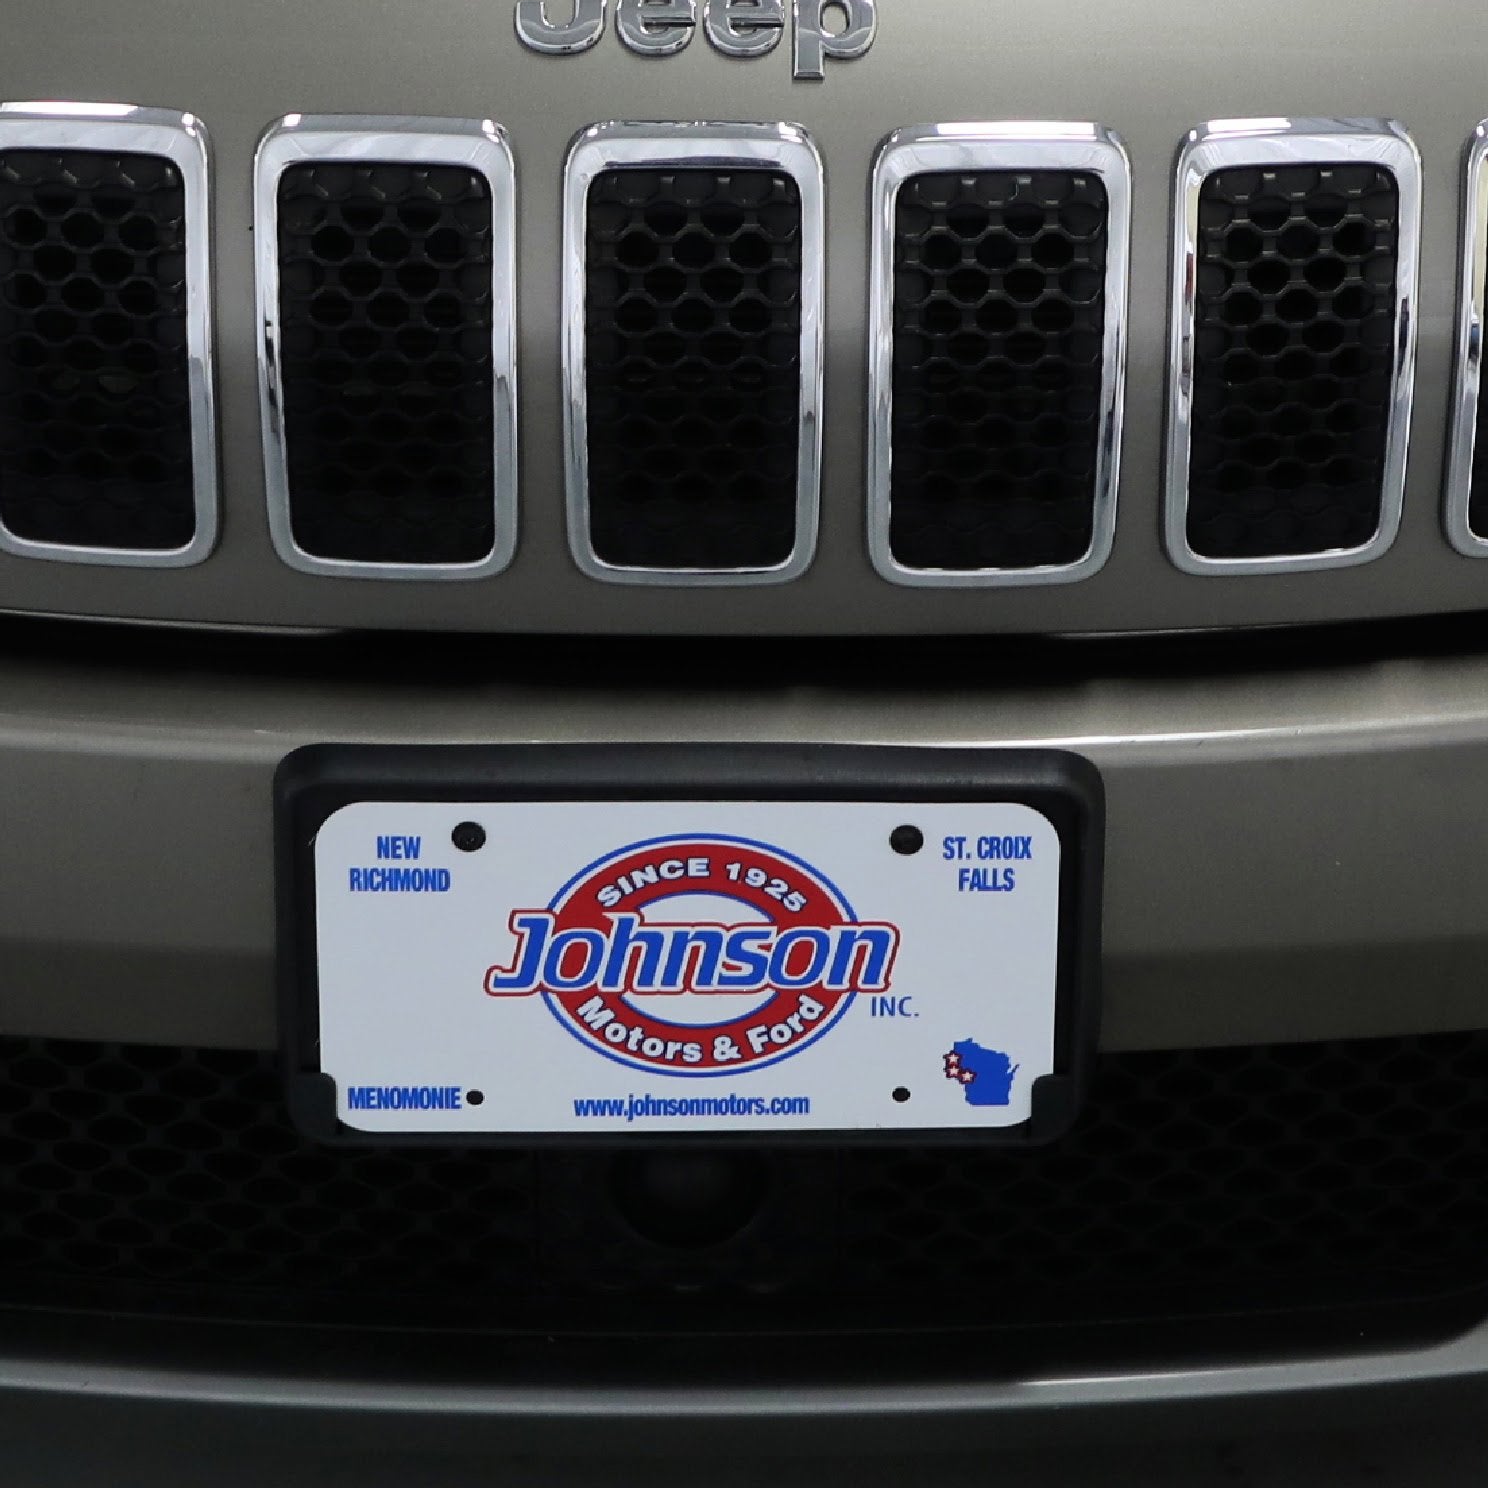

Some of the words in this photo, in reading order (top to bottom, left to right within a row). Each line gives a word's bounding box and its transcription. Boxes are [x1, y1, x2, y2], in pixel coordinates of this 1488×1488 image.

[377, 836, 421, 859] NEW
[942, 837, 971, 859] ST.
[977, 837, 1032, 859] CROIX
[349, 868, 451, 892] RICHMOND
[597, 857, 711, 909] SINCE
[725, 862, 808, 912] 1925
[958, 868, 1014, 891] FALLS
[487, 909, 899, 995] Johnson
[870, 996, 920, 1017] INC.
[577, 995, 703, 1063] Motors
[712, 1036, 741, 1062] &
[746, 995, 825, 1053] Ford
[347, 1086, 461, 1109] MENOMONIE
[573, 1092, 810, 1120] www.johnsonmotors.com
